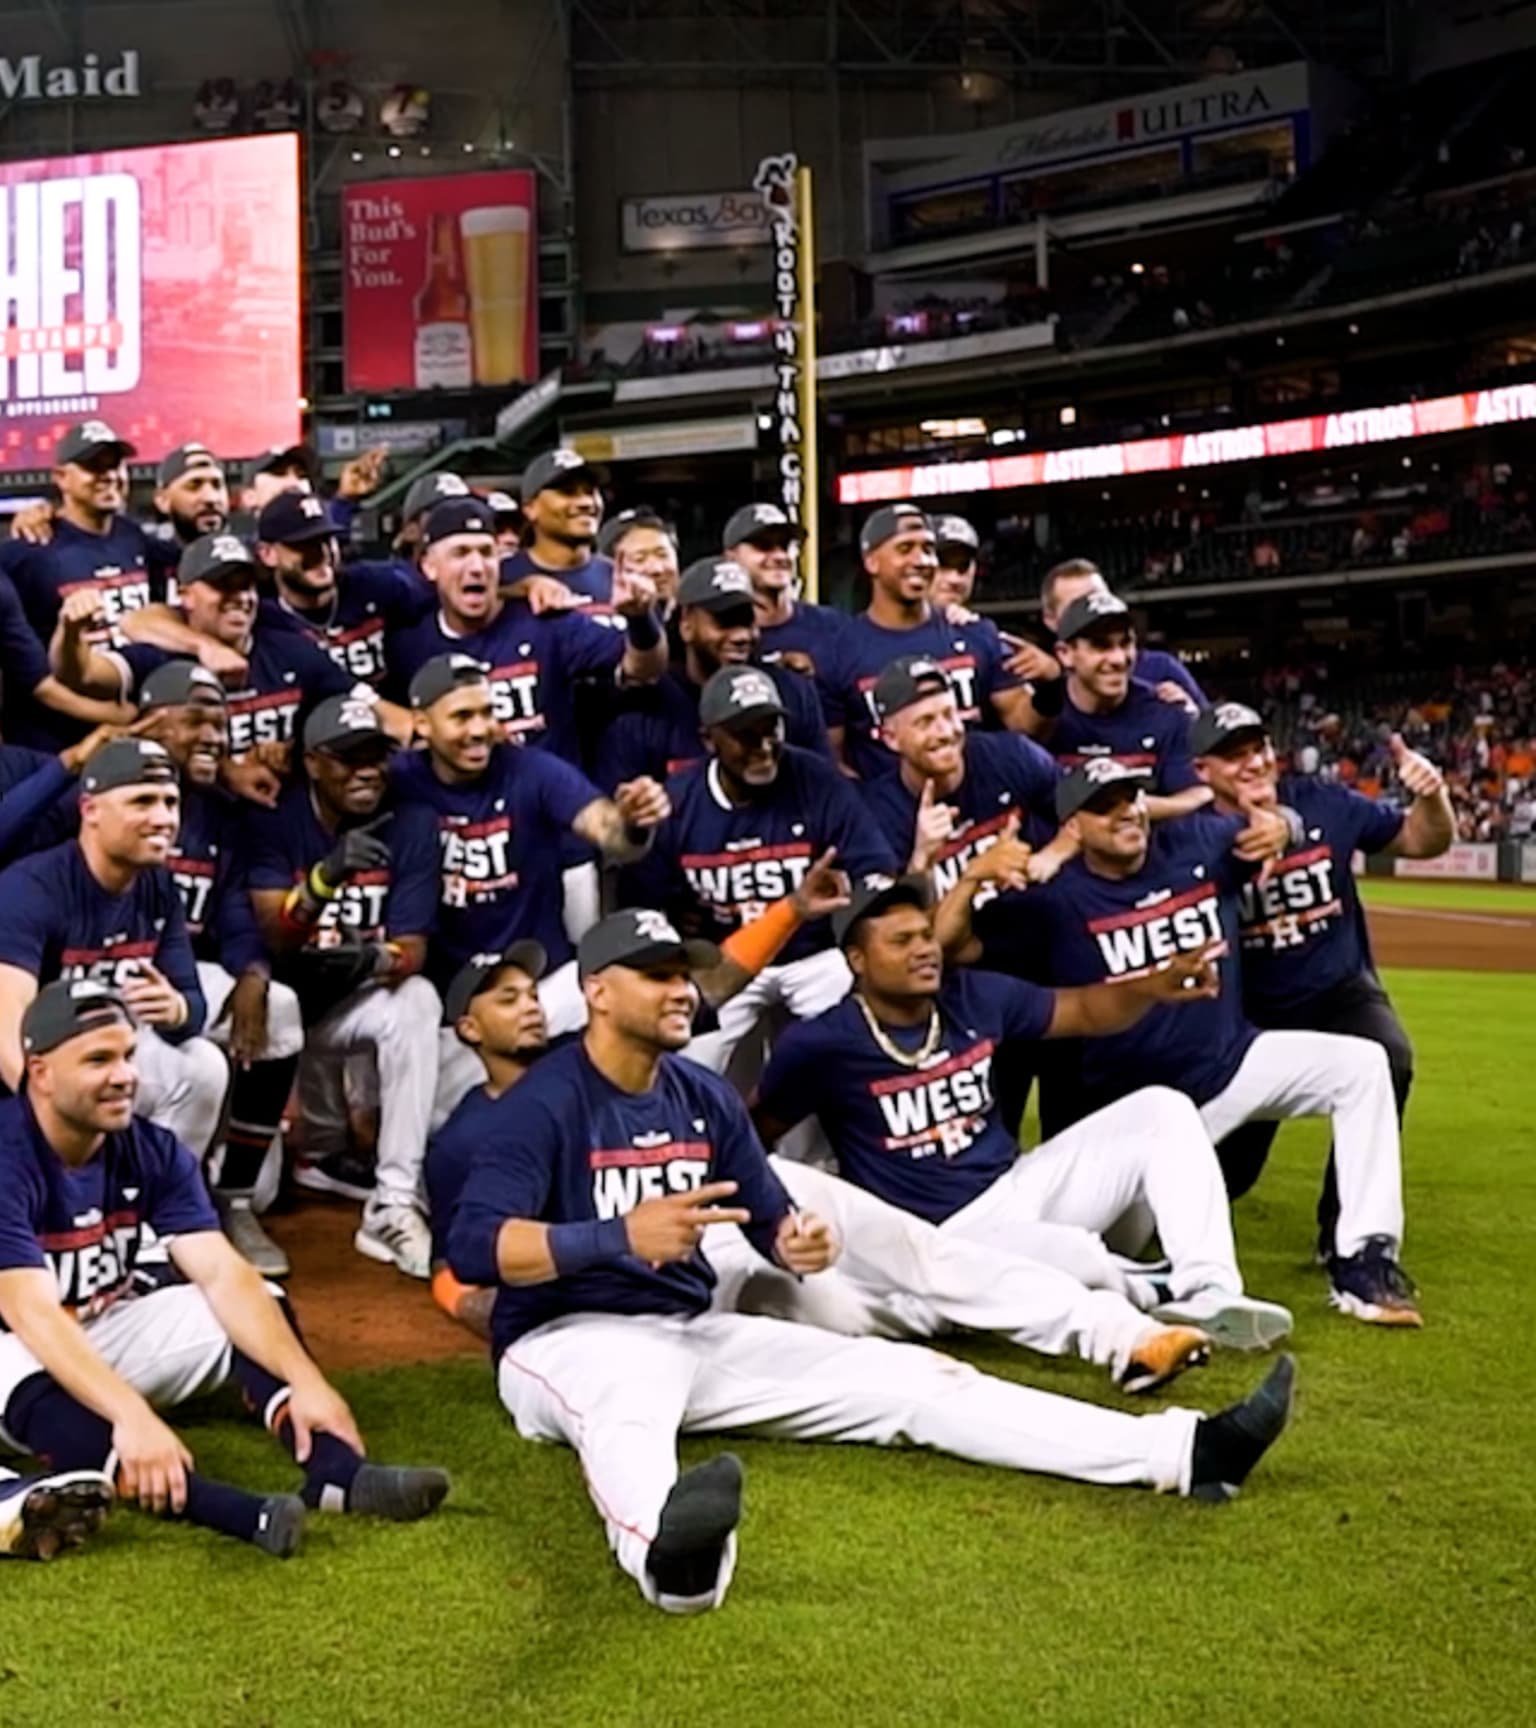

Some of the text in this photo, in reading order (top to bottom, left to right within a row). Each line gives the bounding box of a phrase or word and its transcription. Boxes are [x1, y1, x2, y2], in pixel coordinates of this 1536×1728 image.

[1141, 84, 1272, 135] ULTRA
[348, 197, 404, 221] This
[350, 218, 417, 244] Bud's
[635, 203, 709, 228] Texas
[350, 246, 393, 266] For
[350, 267, 404, 289] You.
[776, 332, 795, 355] 4
[777, 365, 800, 442] THA
[1042, 443, 1125, 483] ASTROS
[1181, 425, 1265, 467] ASTROS
[1325, 403, 1414, 449] ASTROS
[93, 582, 151, 624] EST
[227, 702, 299, 754] EST
[439, 829, 510, 879] EST
[685, 856, 811, 902] WEST
[1095, 895, 1223, 976] WEST
[1270, 915, 1306, 951] H
[878, 1055, 994, 1138] WEST
[592, 1159, 710, 1222] WEST
